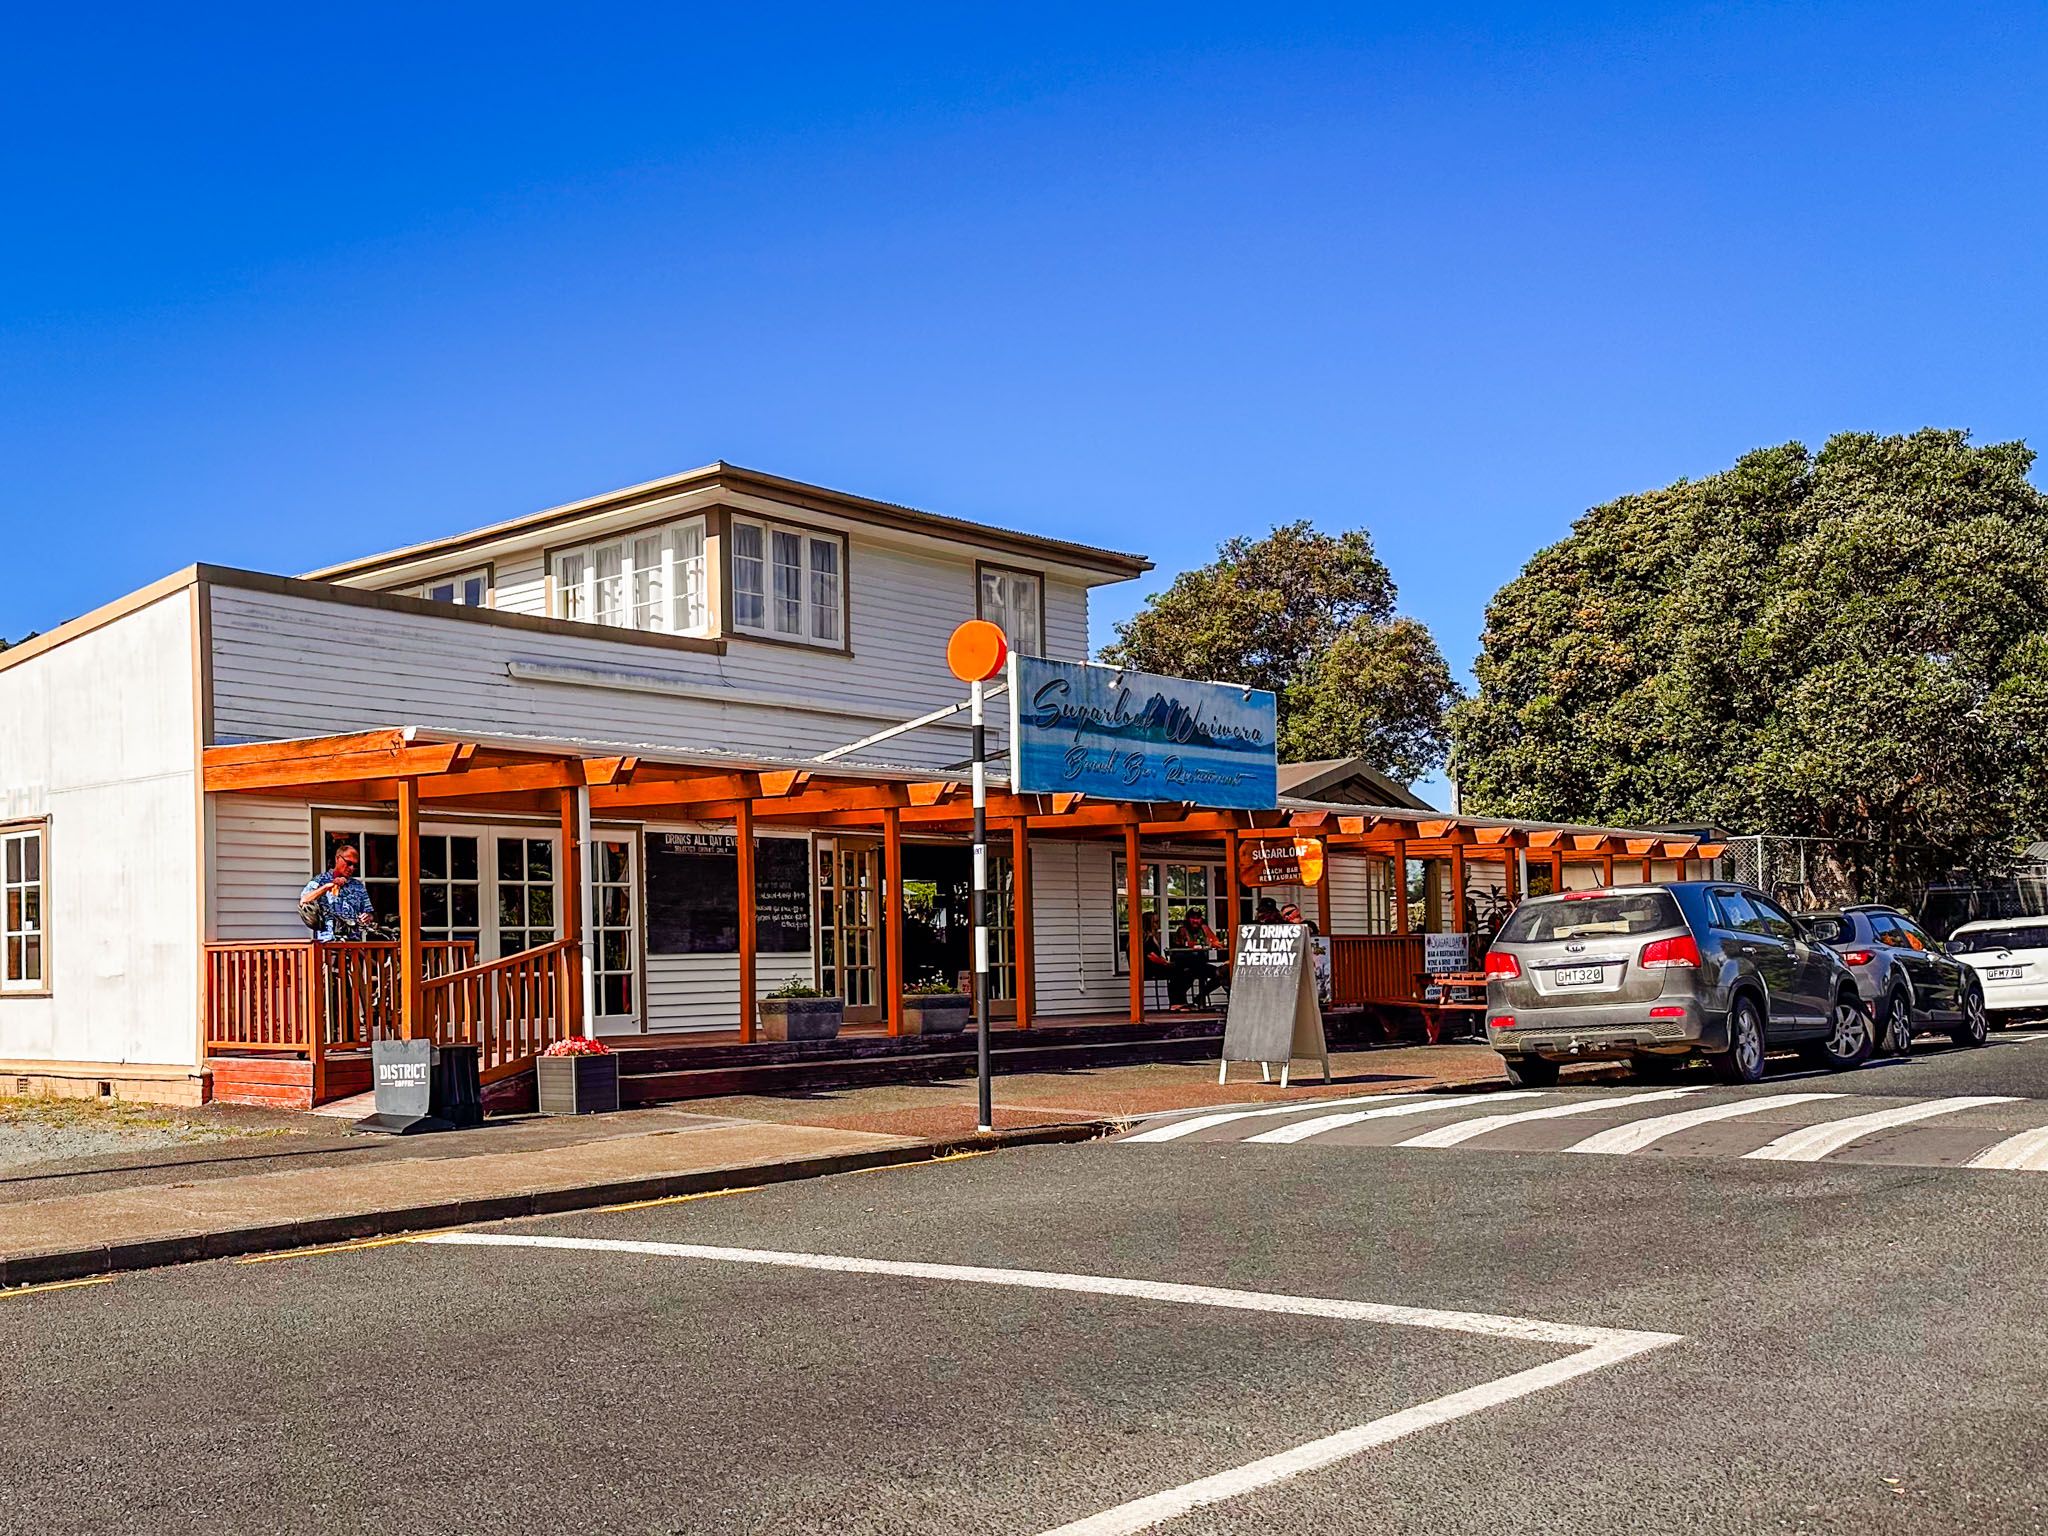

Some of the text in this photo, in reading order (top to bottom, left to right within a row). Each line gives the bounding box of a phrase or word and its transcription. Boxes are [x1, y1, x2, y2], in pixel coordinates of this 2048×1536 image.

[1164, 698, 1264, 744] Waiwera
[665, 833, 691, 845] DRINKS
[694, 835, 708, 846] ALL
[710, 835, 723, 847] DAY
[1252, 845, 1308, 860] SUGARLOAF
[1241, 925, 1301, 939] $7 DRINKS
[1244, 938, 1294, 952] ALL DAY
[1237, 952, 1297, 966] EVERYDAY
[1558, 969, 1600, 981] GHT320
[380, 1063, 426, 1080] DISTRICT
